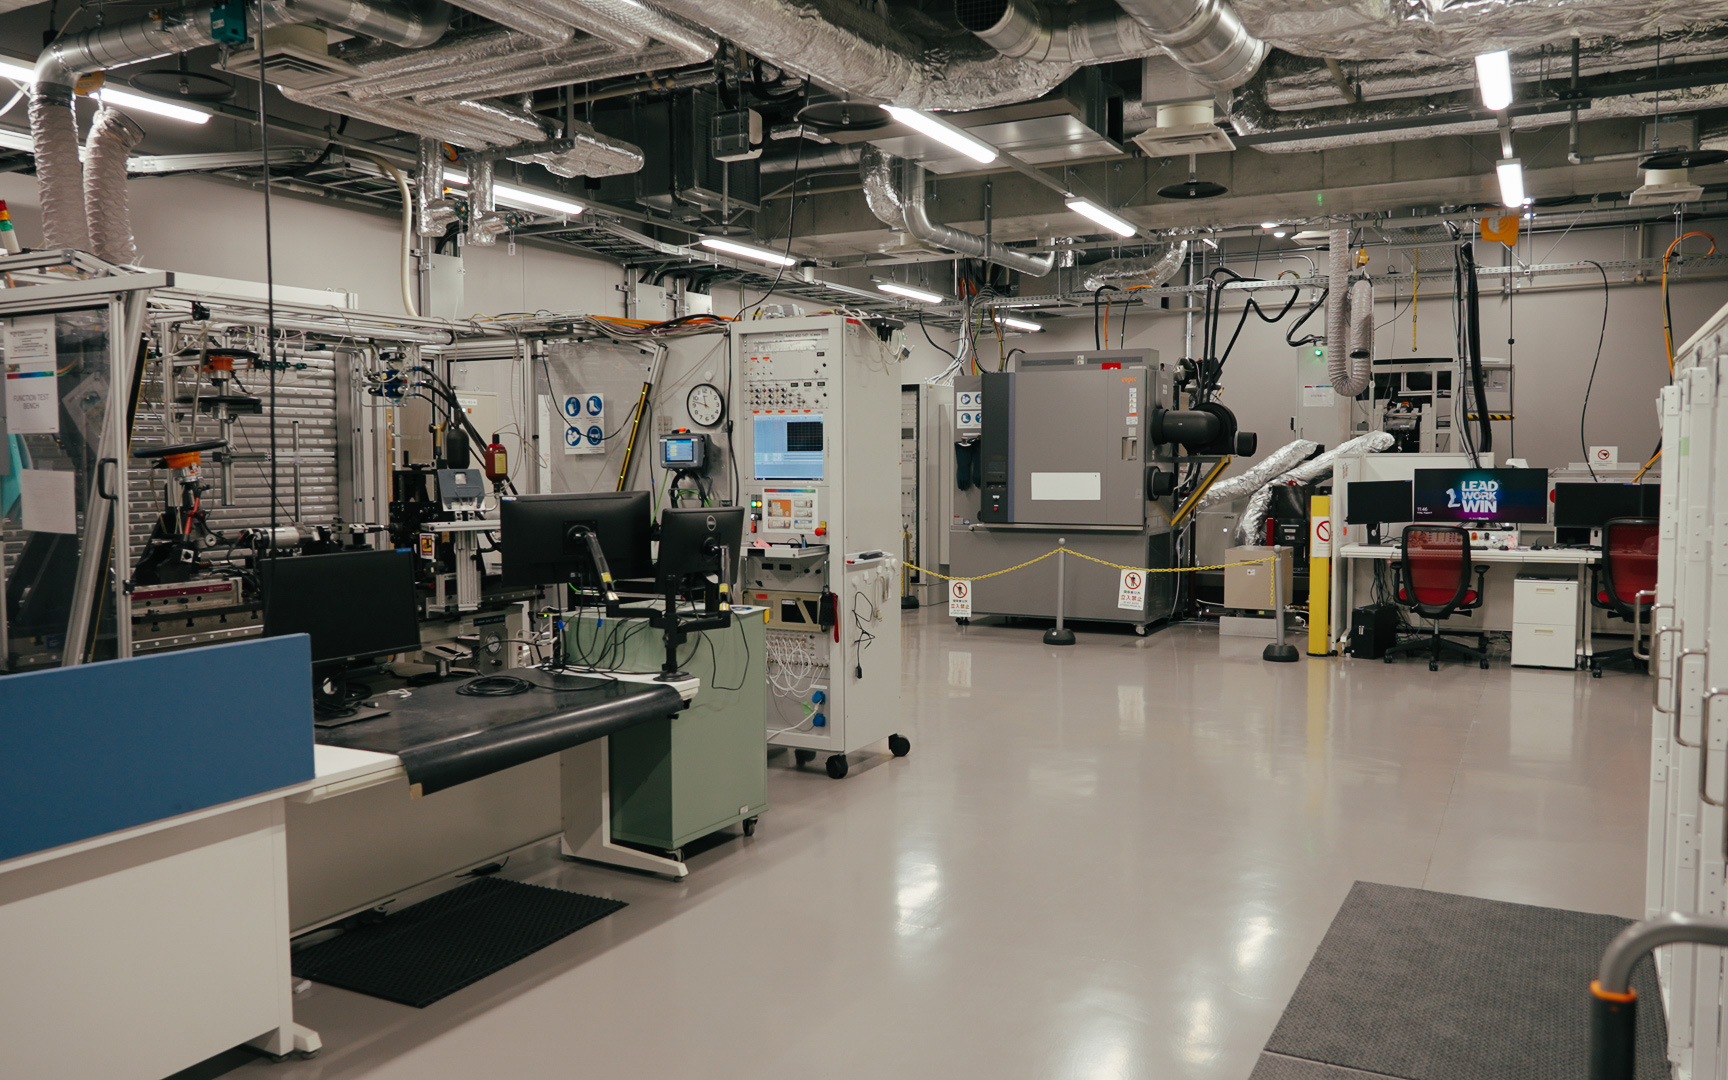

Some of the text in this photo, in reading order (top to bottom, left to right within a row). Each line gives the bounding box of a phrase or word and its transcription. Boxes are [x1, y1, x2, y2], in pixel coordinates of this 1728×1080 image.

[1461, 480, 1499, 491] LEAD
[1462, 492, 1497, 500] WORK
[1462, 500, 1497, 513] WIN
